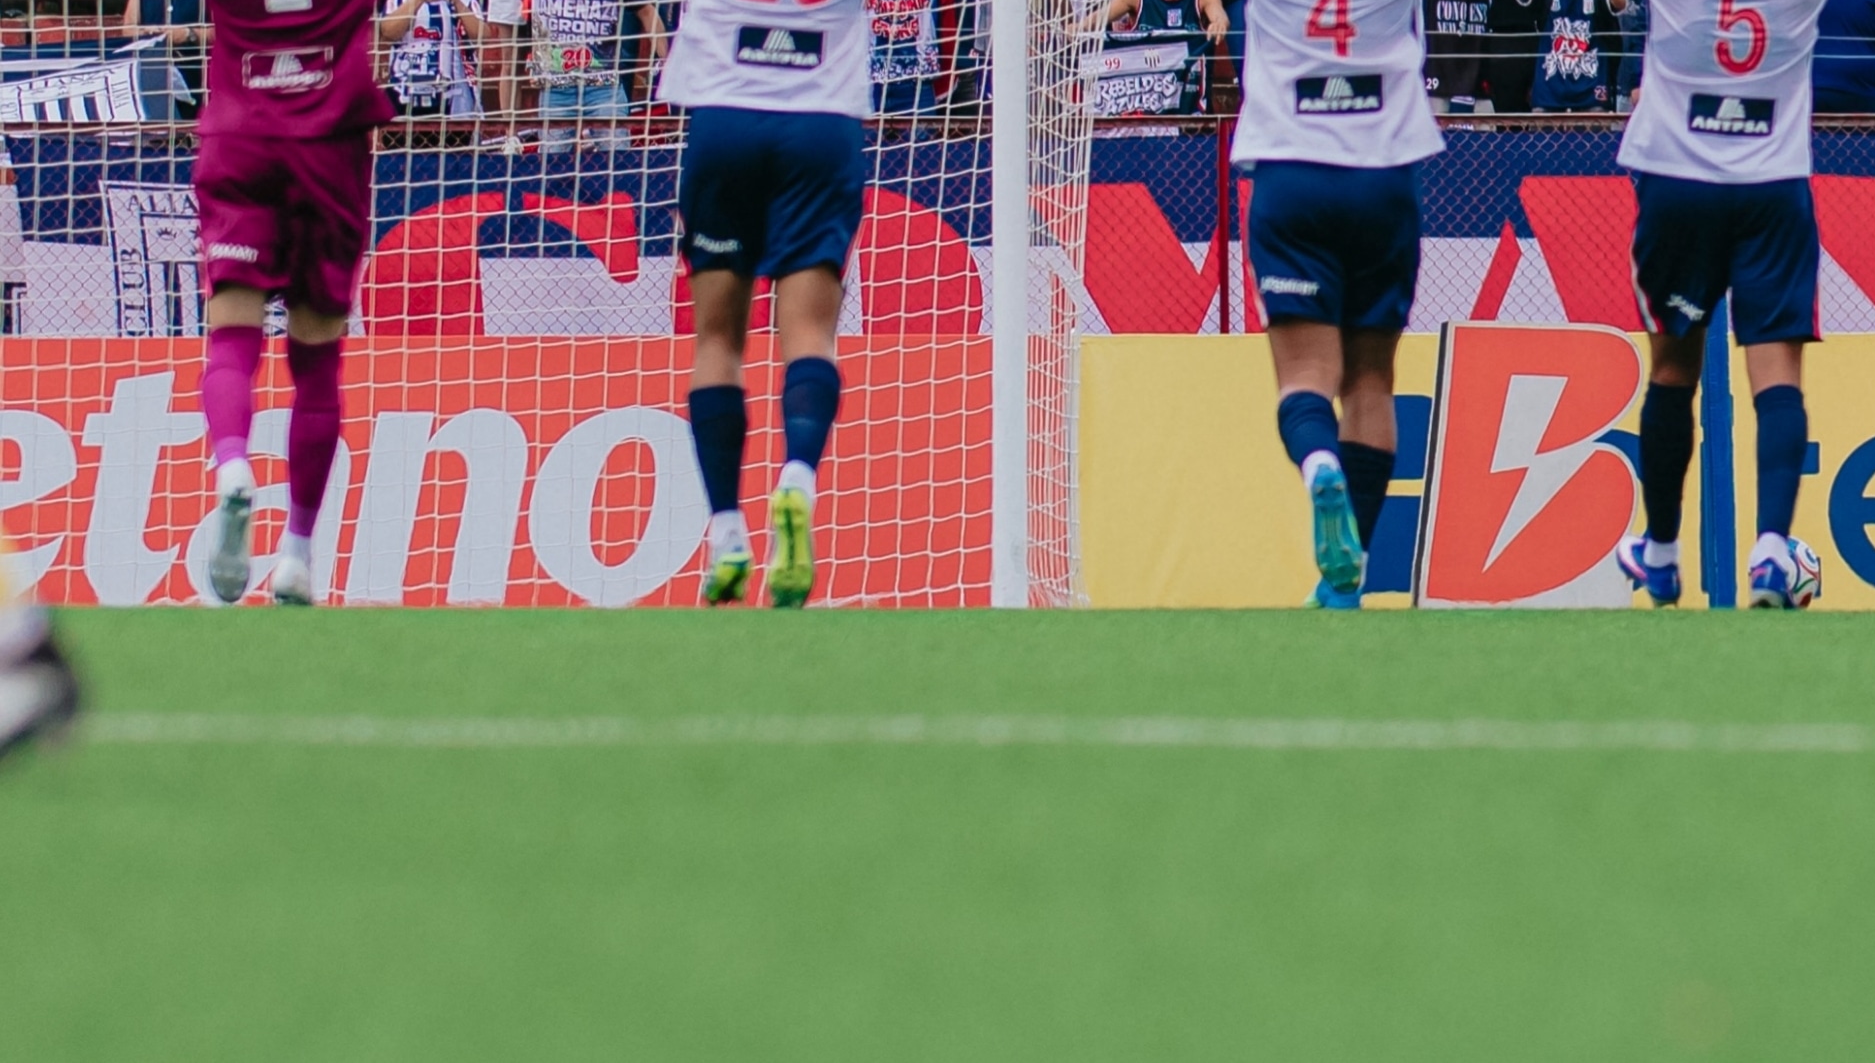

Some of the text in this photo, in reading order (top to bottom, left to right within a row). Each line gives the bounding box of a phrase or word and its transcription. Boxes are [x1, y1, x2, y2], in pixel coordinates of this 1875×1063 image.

[1436, 1, 1467, 21] CONO
[1104, 57, 1121, 70] 99
[1426, 77, 1439, 90] 29
[1690, 116, 1770, 135] ANYPSA
[120, 247, 146, 337] CLUB
